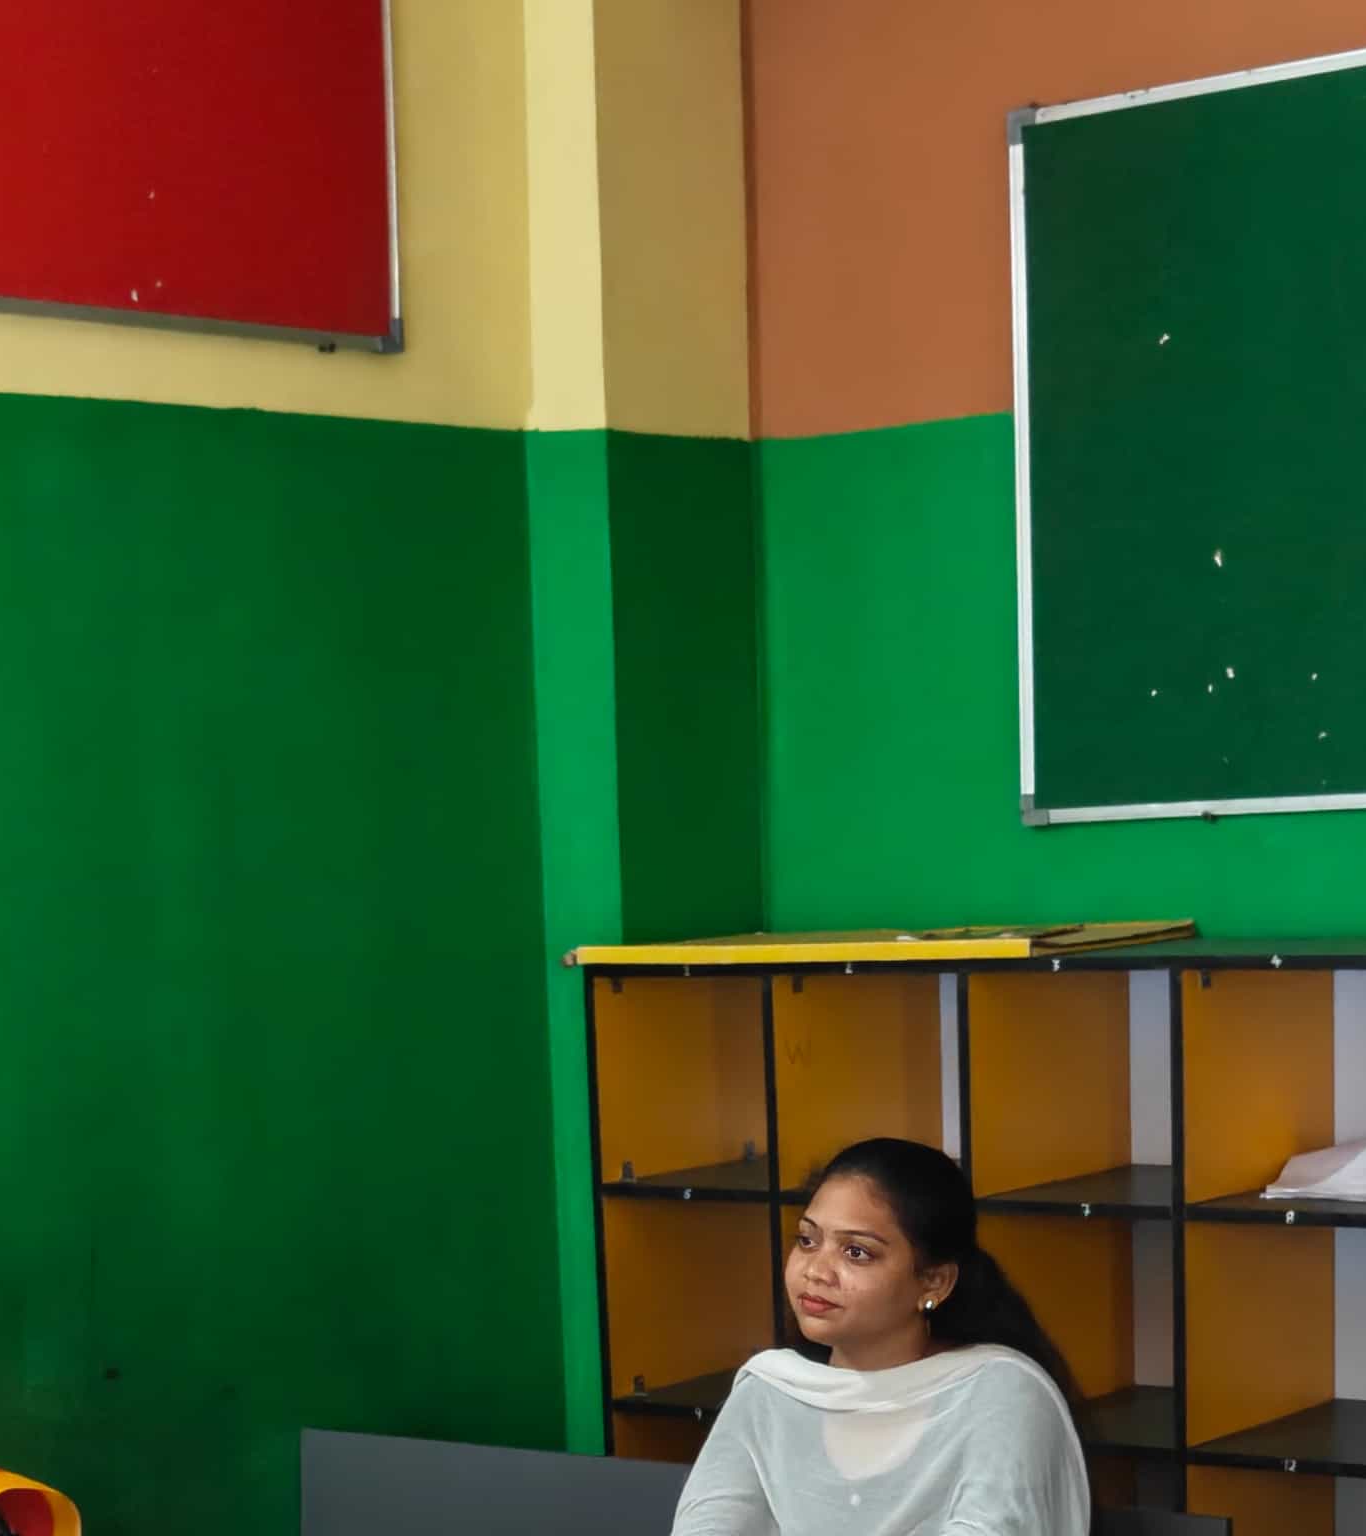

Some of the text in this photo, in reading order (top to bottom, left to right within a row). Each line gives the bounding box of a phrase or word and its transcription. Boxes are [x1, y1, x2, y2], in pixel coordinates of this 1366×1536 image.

[1051, 959, 1061, 973] 3
[1270, 954, 1282, 969] 4
[1081, 1203, 1092, 1217] 7
[1285, 1210, 1295, 1224] 8
[694, 1408, 702, 1420] 9
[1283, 1458, 1297, 1473] 12
